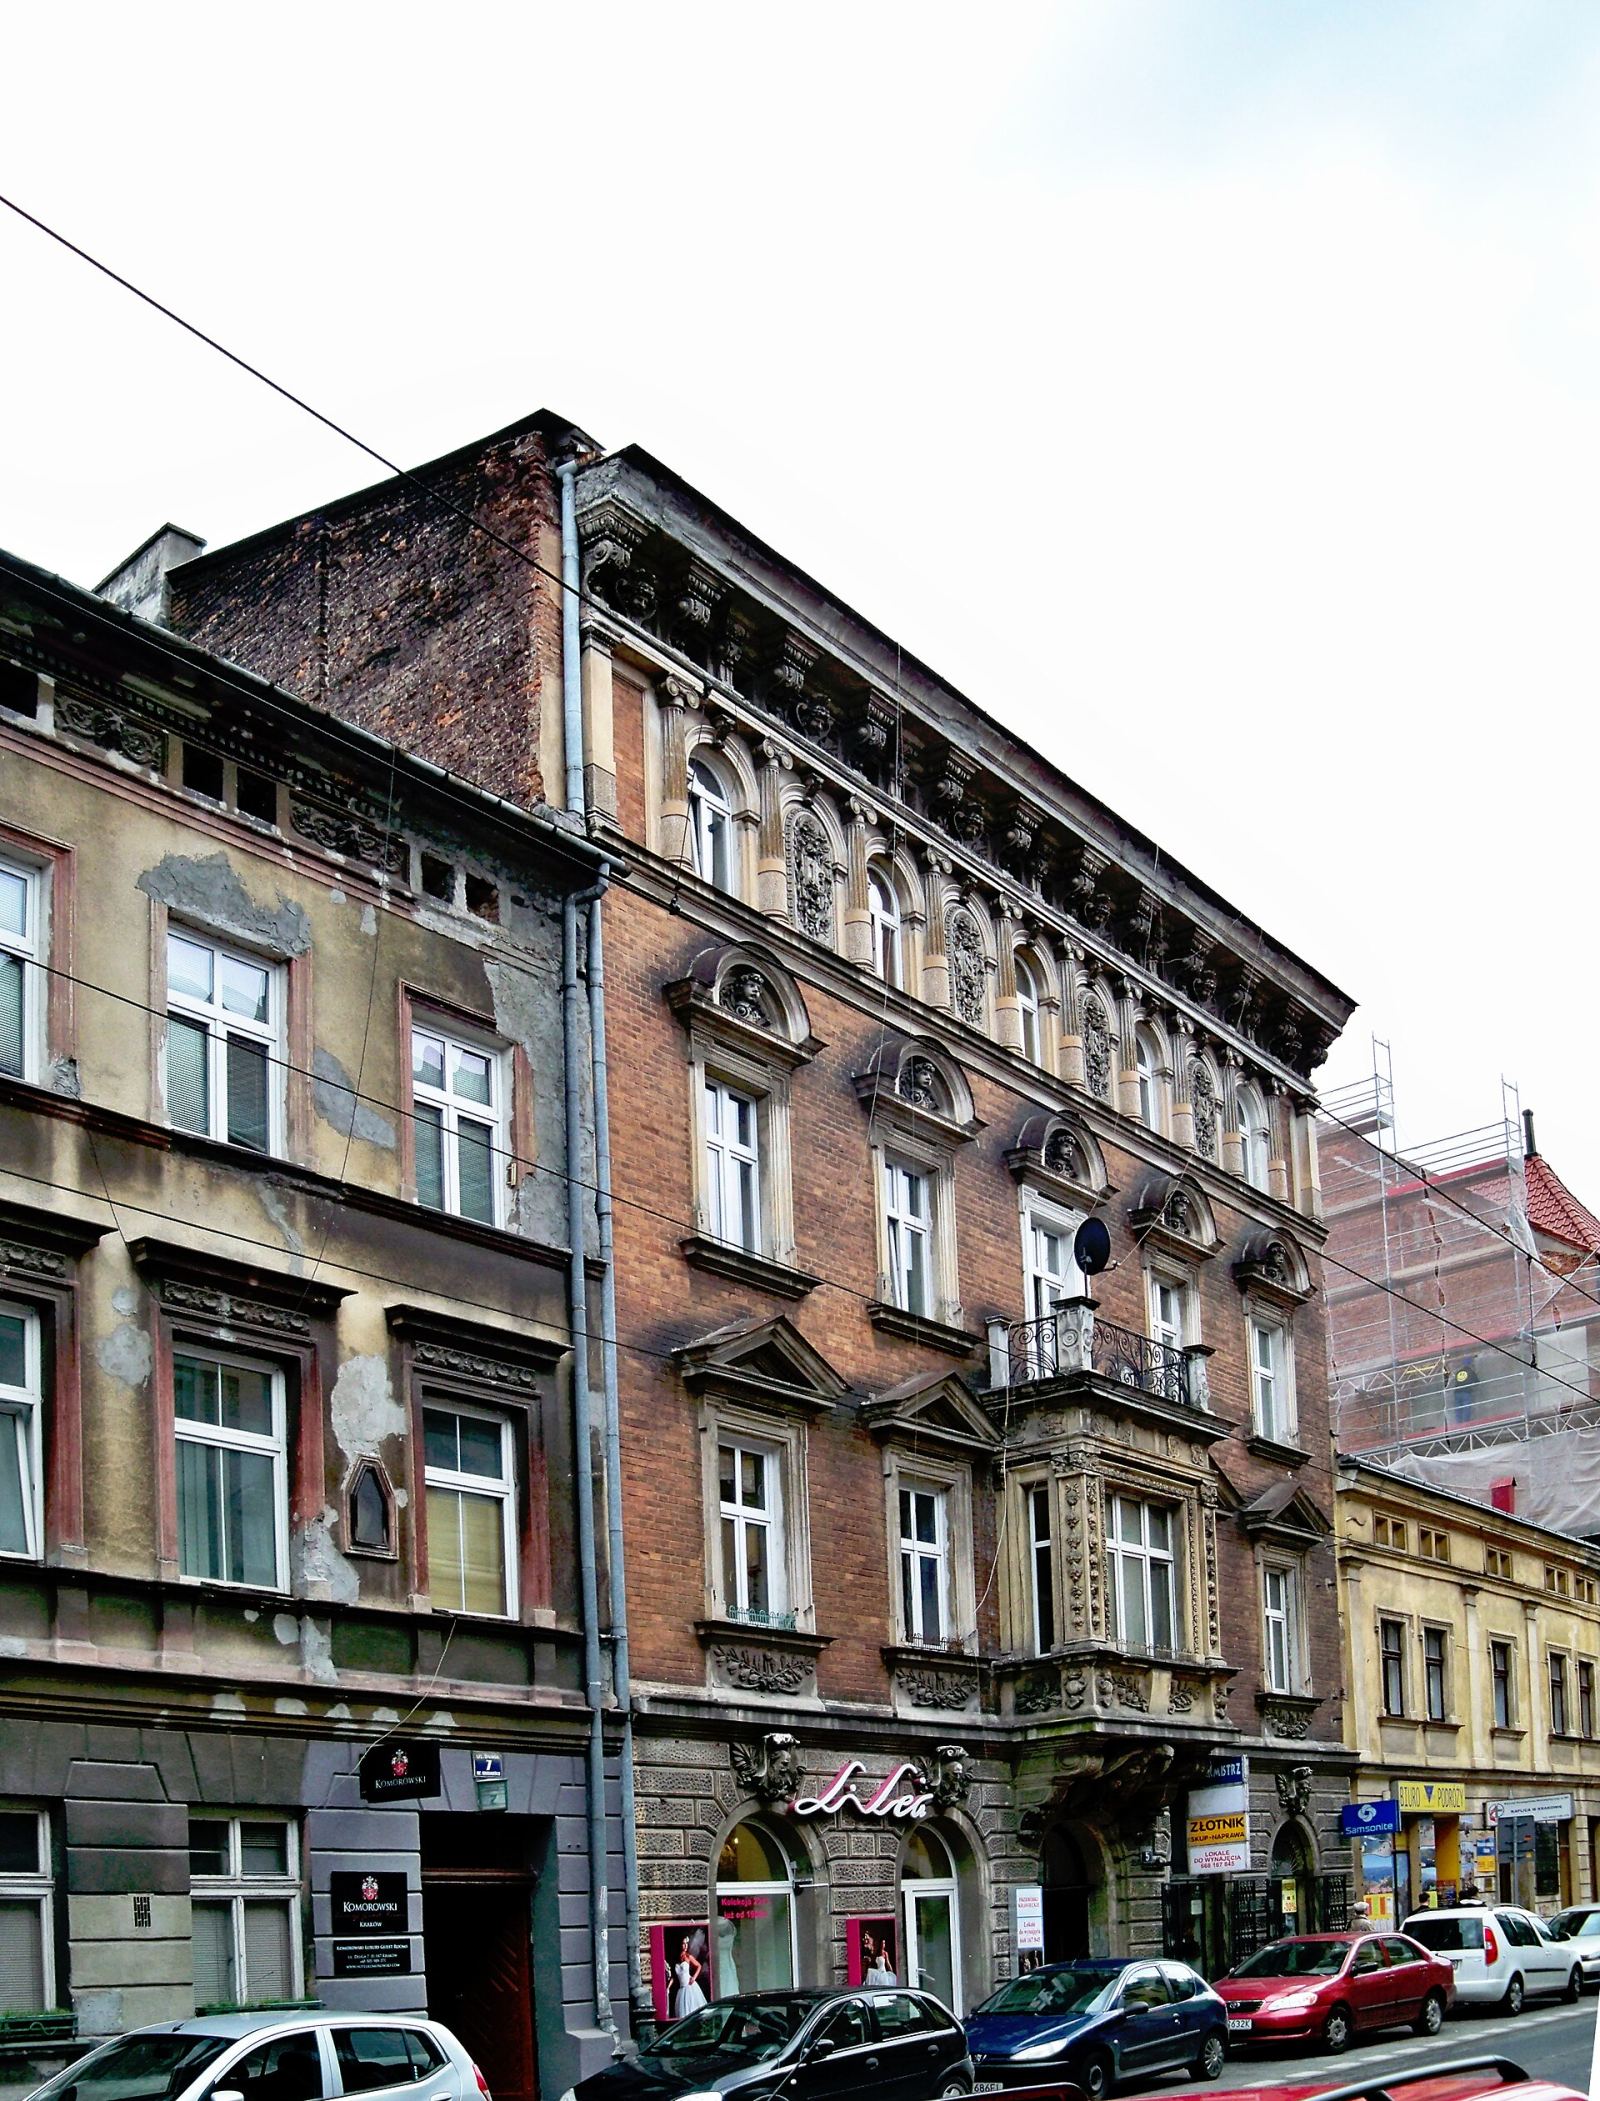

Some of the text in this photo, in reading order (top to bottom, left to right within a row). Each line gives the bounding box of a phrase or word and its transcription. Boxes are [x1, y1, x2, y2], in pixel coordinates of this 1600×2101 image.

[486, 1759, 492, 1771] 7
[375, 1776, 426, 1789] KOMOROWSKI
[1400, 1786, 1420, 1808] BIURO
[1190, 1817, 1244, 1832] ZŁOTNIK
[1345, 1823, 1393, 1834] Samsonite
[343, 1902, 397, 1912] KOMOROWSKI
[736, 1911, 745, 1919] od
